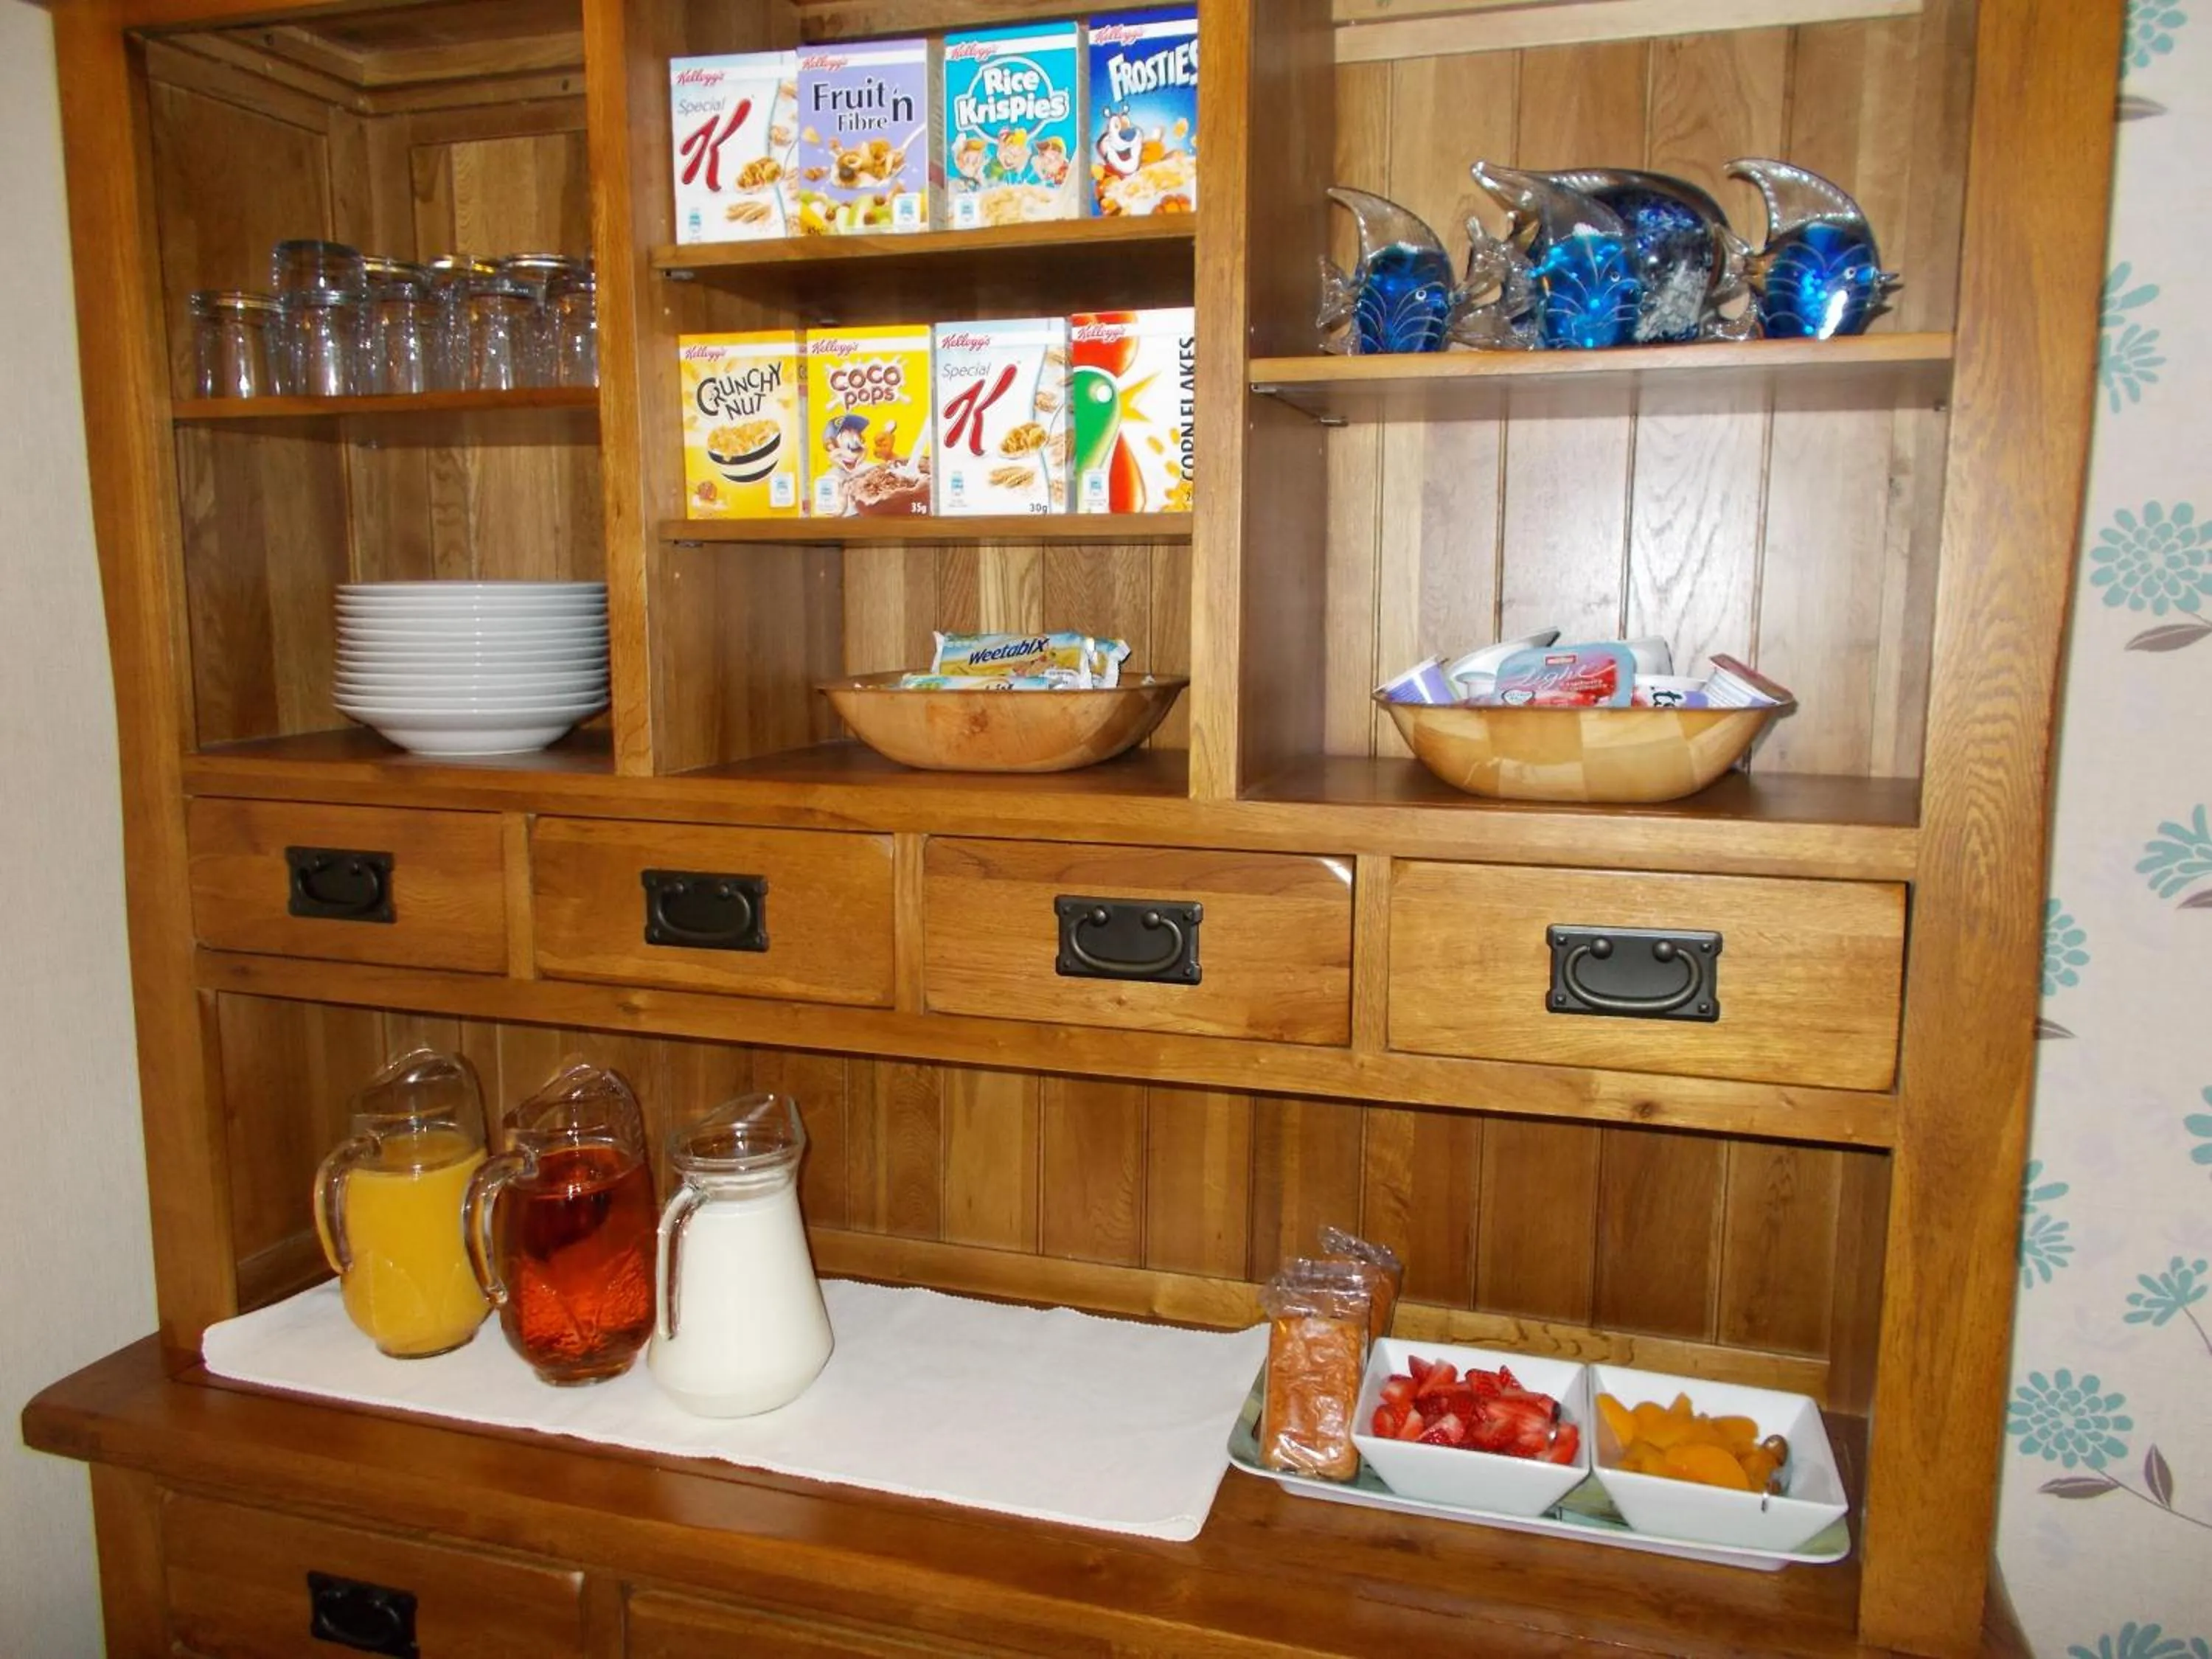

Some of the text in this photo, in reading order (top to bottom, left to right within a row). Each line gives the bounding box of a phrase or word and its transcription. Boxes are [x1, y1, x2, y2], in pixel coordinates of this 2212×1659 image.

[676, 68, 726, 86] Kellogg's
[982, 67, 1040, 94] Rice
[813, 77, 886, 111] Fruit
[678, 98, 726, 115] Special
[958, 94, 1067, 126] Krispies
[838, 112, 888, 131] Fibre
[680, 98, 752, 192] K
[942, 333, 992, 352] Kellogg's
[1077, 325, 1126, 341] Kellogg's
[812, 339, 859, 356] Kellogg's
[942, 362, 991, 380] Special
[696, 361, 782, 417] CRUNCHY
[724, 392, 766, 420] NUT
[943, 364, 1018, 456] K
[1029, 502, 1048, 514] 30g
[967, 637, 1050, 665] Weetabix
